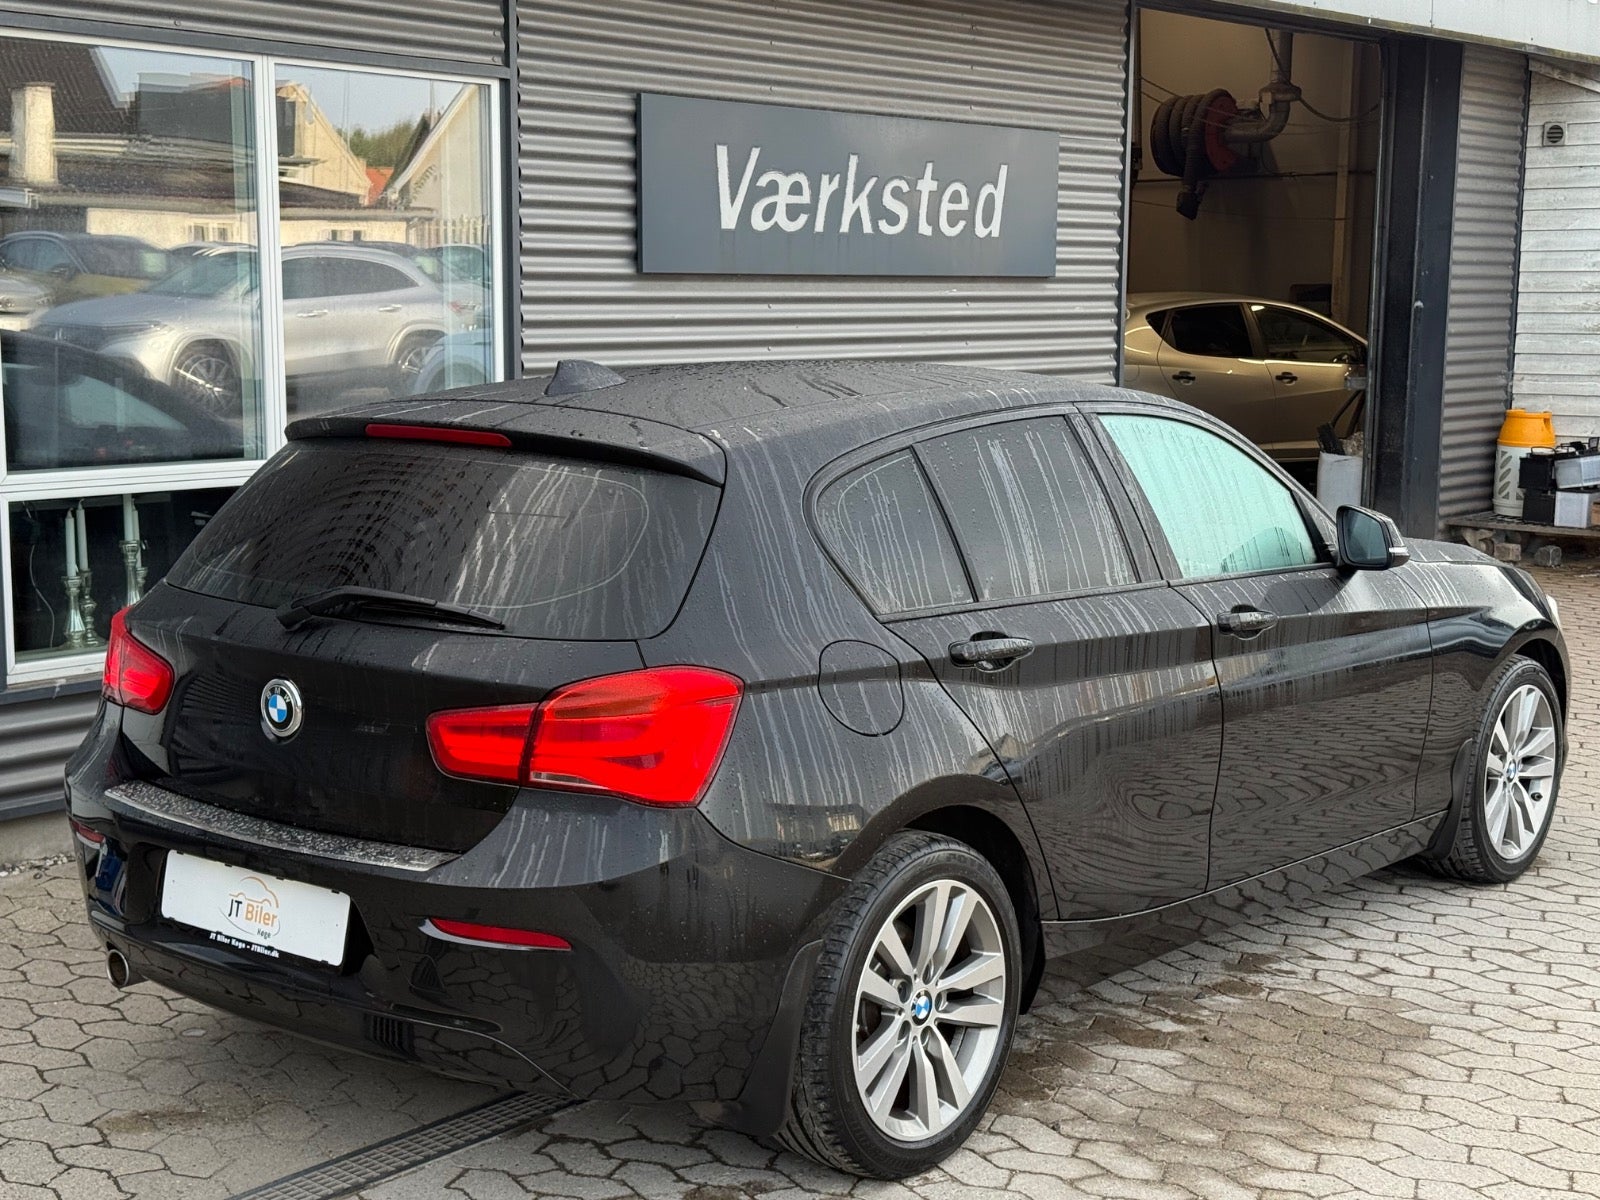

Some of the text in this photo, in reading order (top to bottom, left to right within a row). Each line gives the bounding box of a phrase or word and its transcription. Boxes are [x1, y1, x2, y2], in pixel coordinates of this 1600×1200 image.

[716, 144, 1008, 239] Værksted
[228, 899, 278, 927] JT Biler
[209, 932, 216, 940] JT
